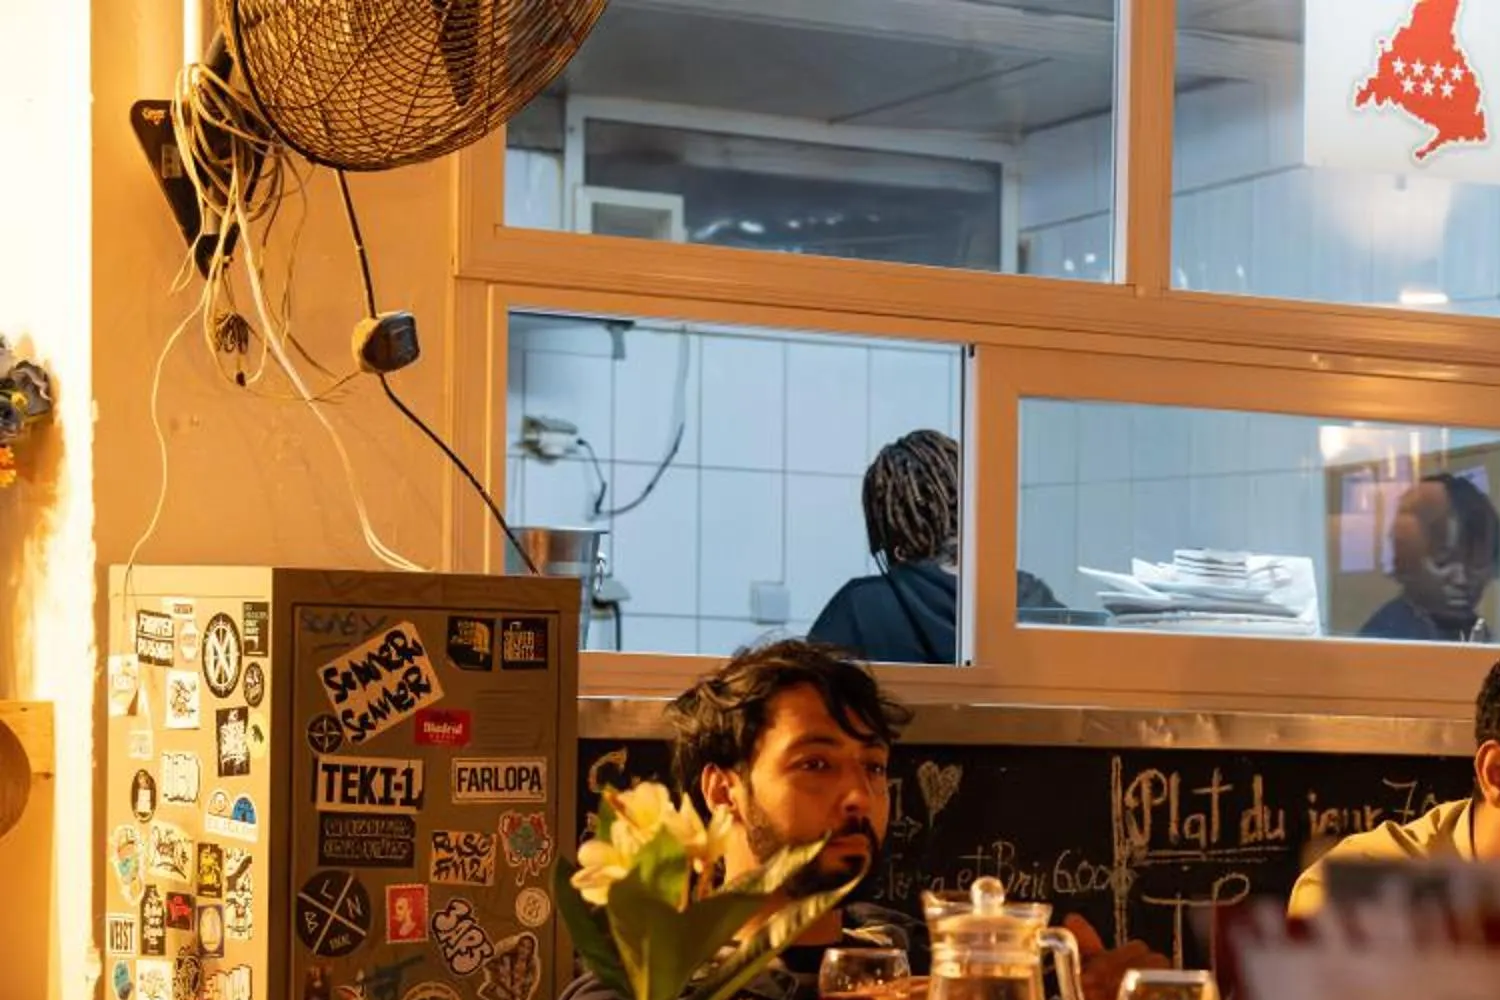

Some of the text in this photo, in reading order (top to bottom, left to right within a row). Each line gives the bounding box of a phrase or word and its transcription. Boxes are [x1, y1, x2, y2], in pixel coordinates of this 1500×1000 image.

[457, 767, 542, 793] FARLOPA
[1125, 769, 1233, 850] Plat
[1238, 774, 1286, 845] du
